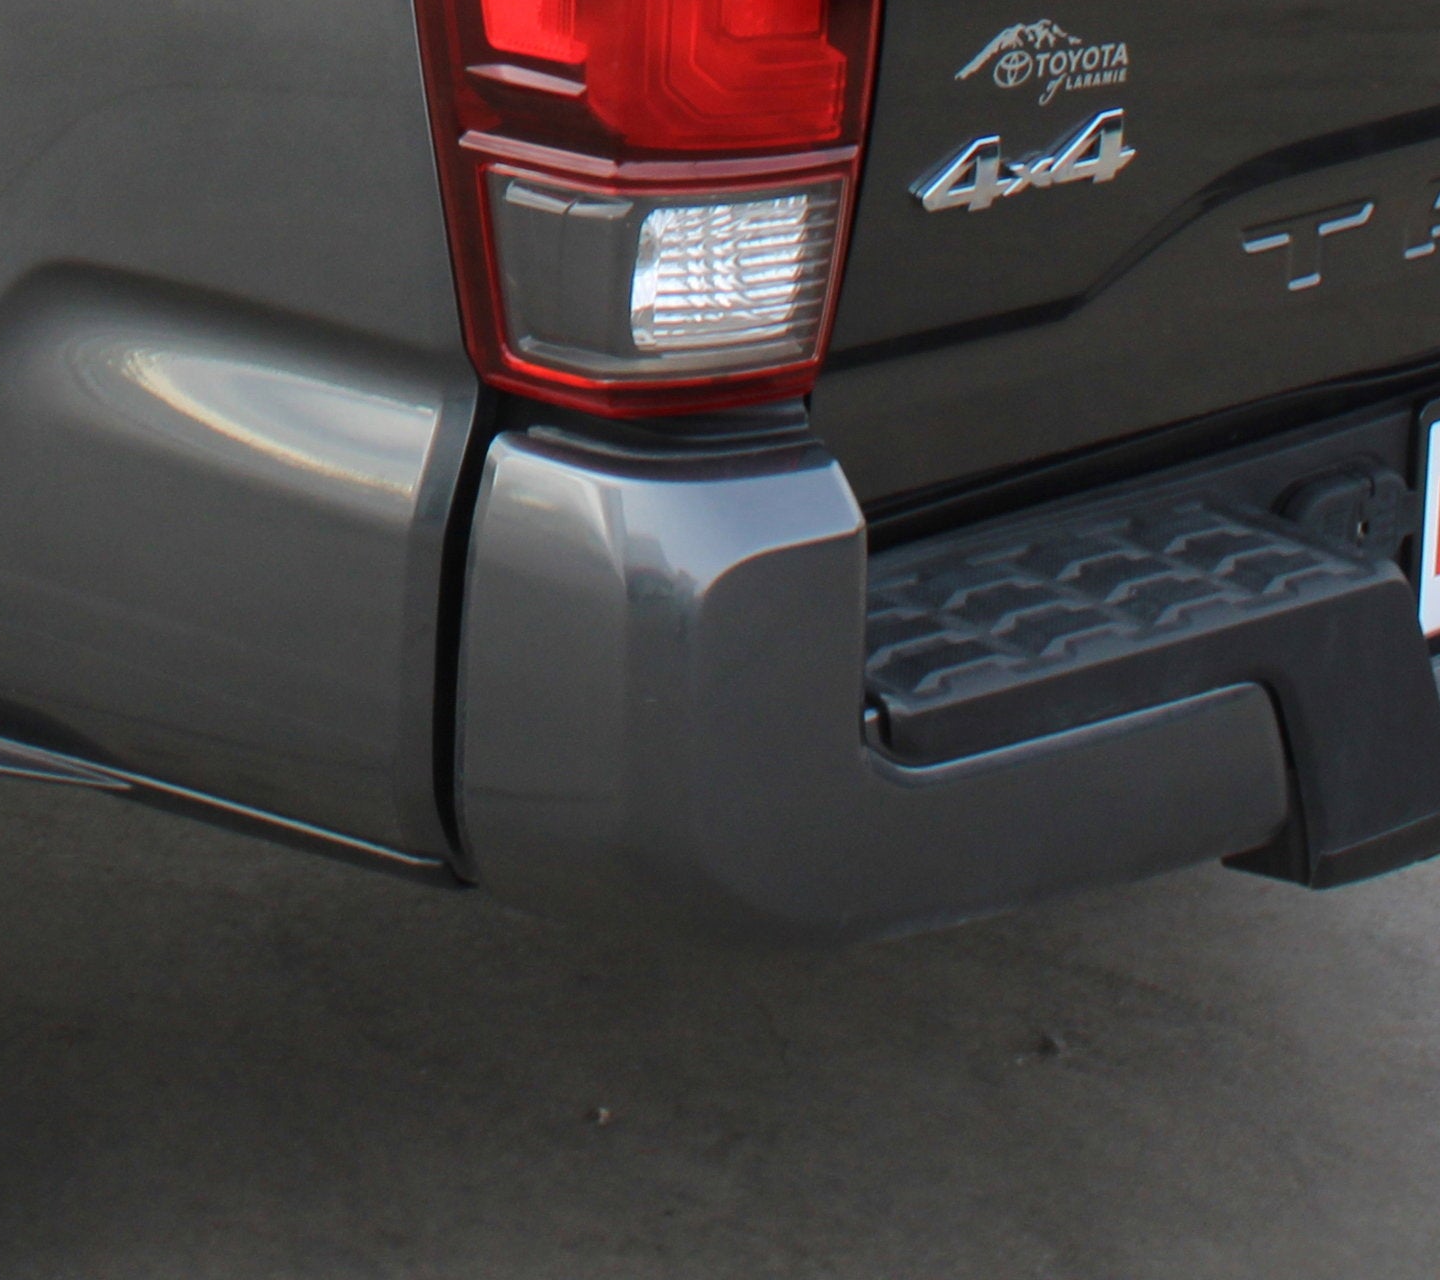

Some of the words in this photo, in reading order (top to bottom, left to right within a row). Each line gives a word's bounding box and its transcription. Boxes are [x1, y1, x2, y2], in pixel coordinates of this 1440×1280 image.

[1034, 42, 1130, 78] TOYOTA
[1037, 72, 1068, 107] of
[1065, 67, 1129, 91] LARAMIE
[910, 106, 1137, 213] 4x4
